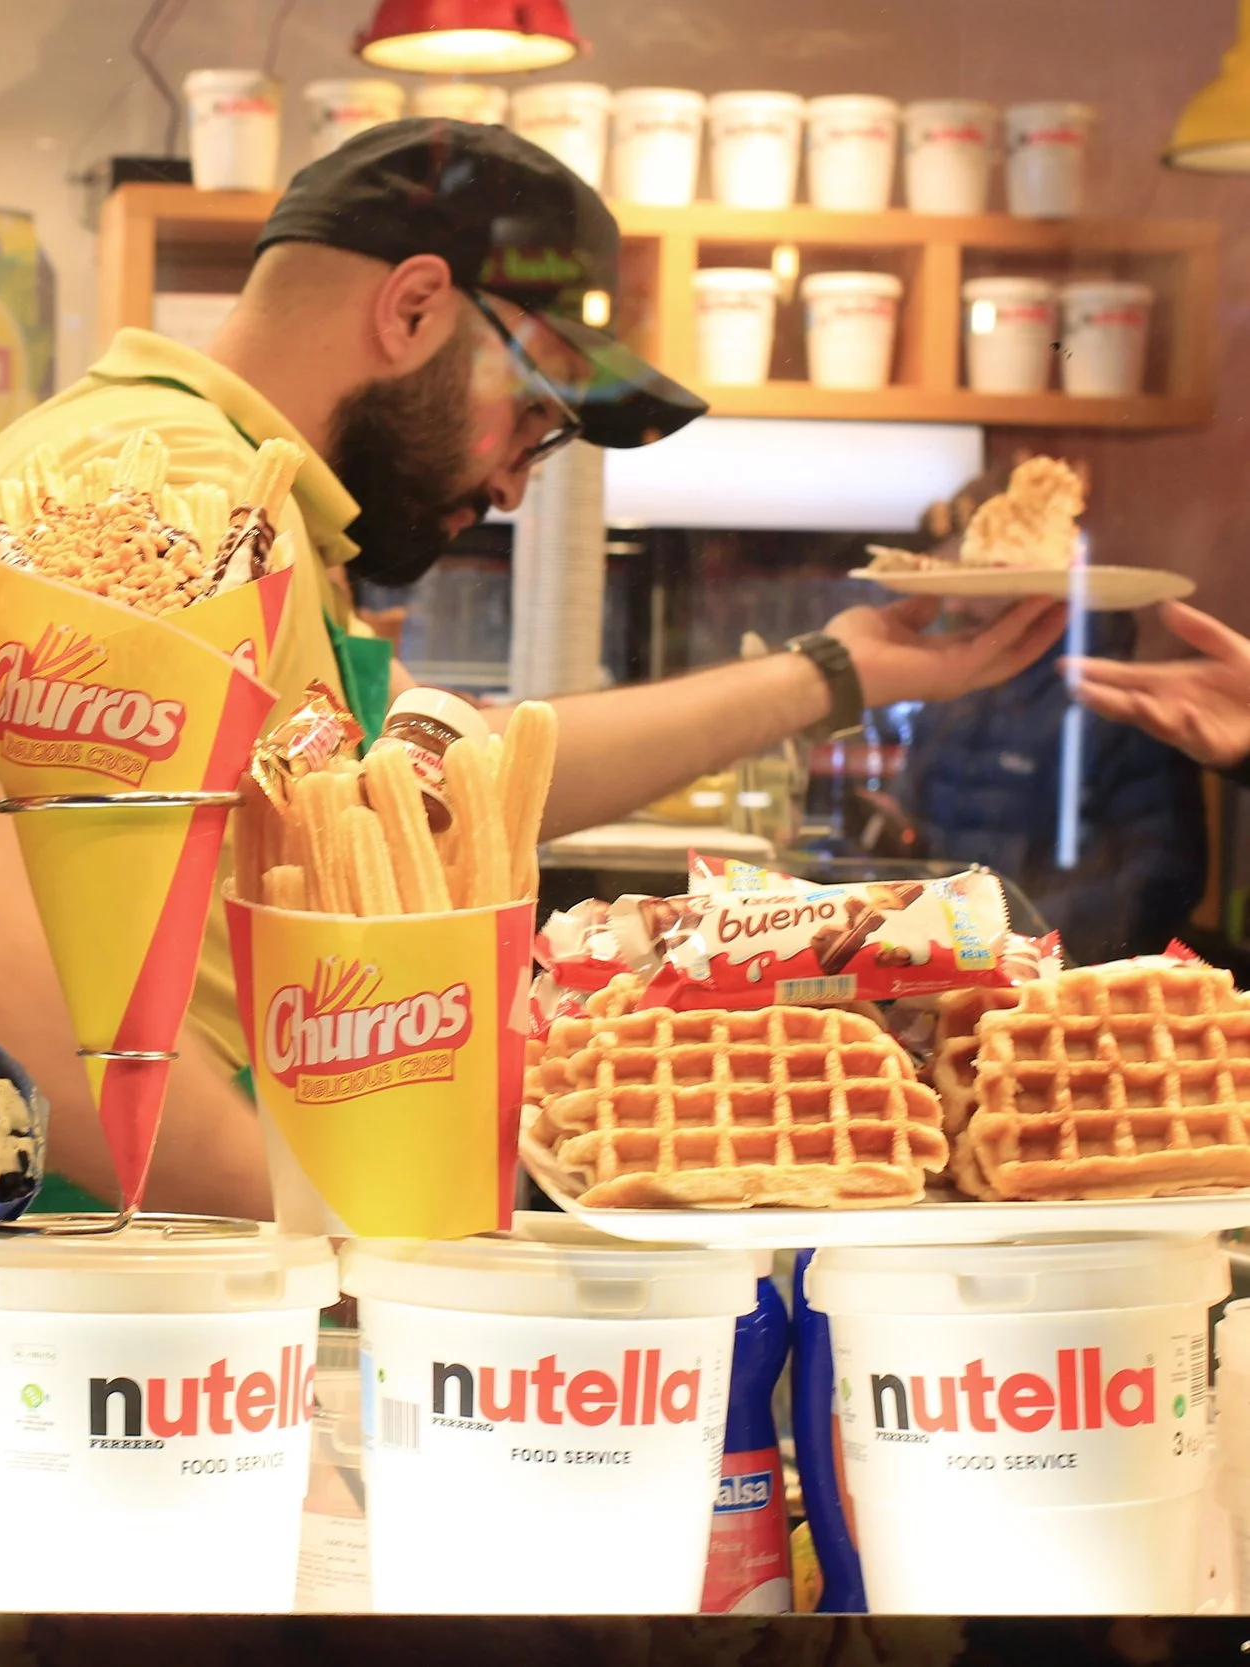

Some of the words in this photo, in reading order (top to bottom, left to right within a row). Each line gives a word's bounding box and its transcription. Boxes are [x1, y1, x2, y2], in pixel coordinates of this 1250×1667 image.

[5, 741, 82, 763] DELICIOUS
[85, 745, 143, 775] CRISP
[718, 902, 836, 943] bueno
[266, 982, 468, 1075] Churros
[300, 1063, 392, 1098] DELICIOUS
[397, 1053, 450, 1078] CRISP
[431, 1348, 702, 1428] nutella
[870, 1346, 1156, 1434] nutella
[88, 1438, 166, 1450] FERRERO
[510, 1447, 557, 1464] FOOD
[563, 1449, 633, 1466] SERVICE
[946, 1454, 996, 1471] FOOD
[1003, 1452, 1078, 1471] SERVICE
[180, 1459, 229, 1476] FOOD
[235, 1452, 284, 1473] SERVICE
